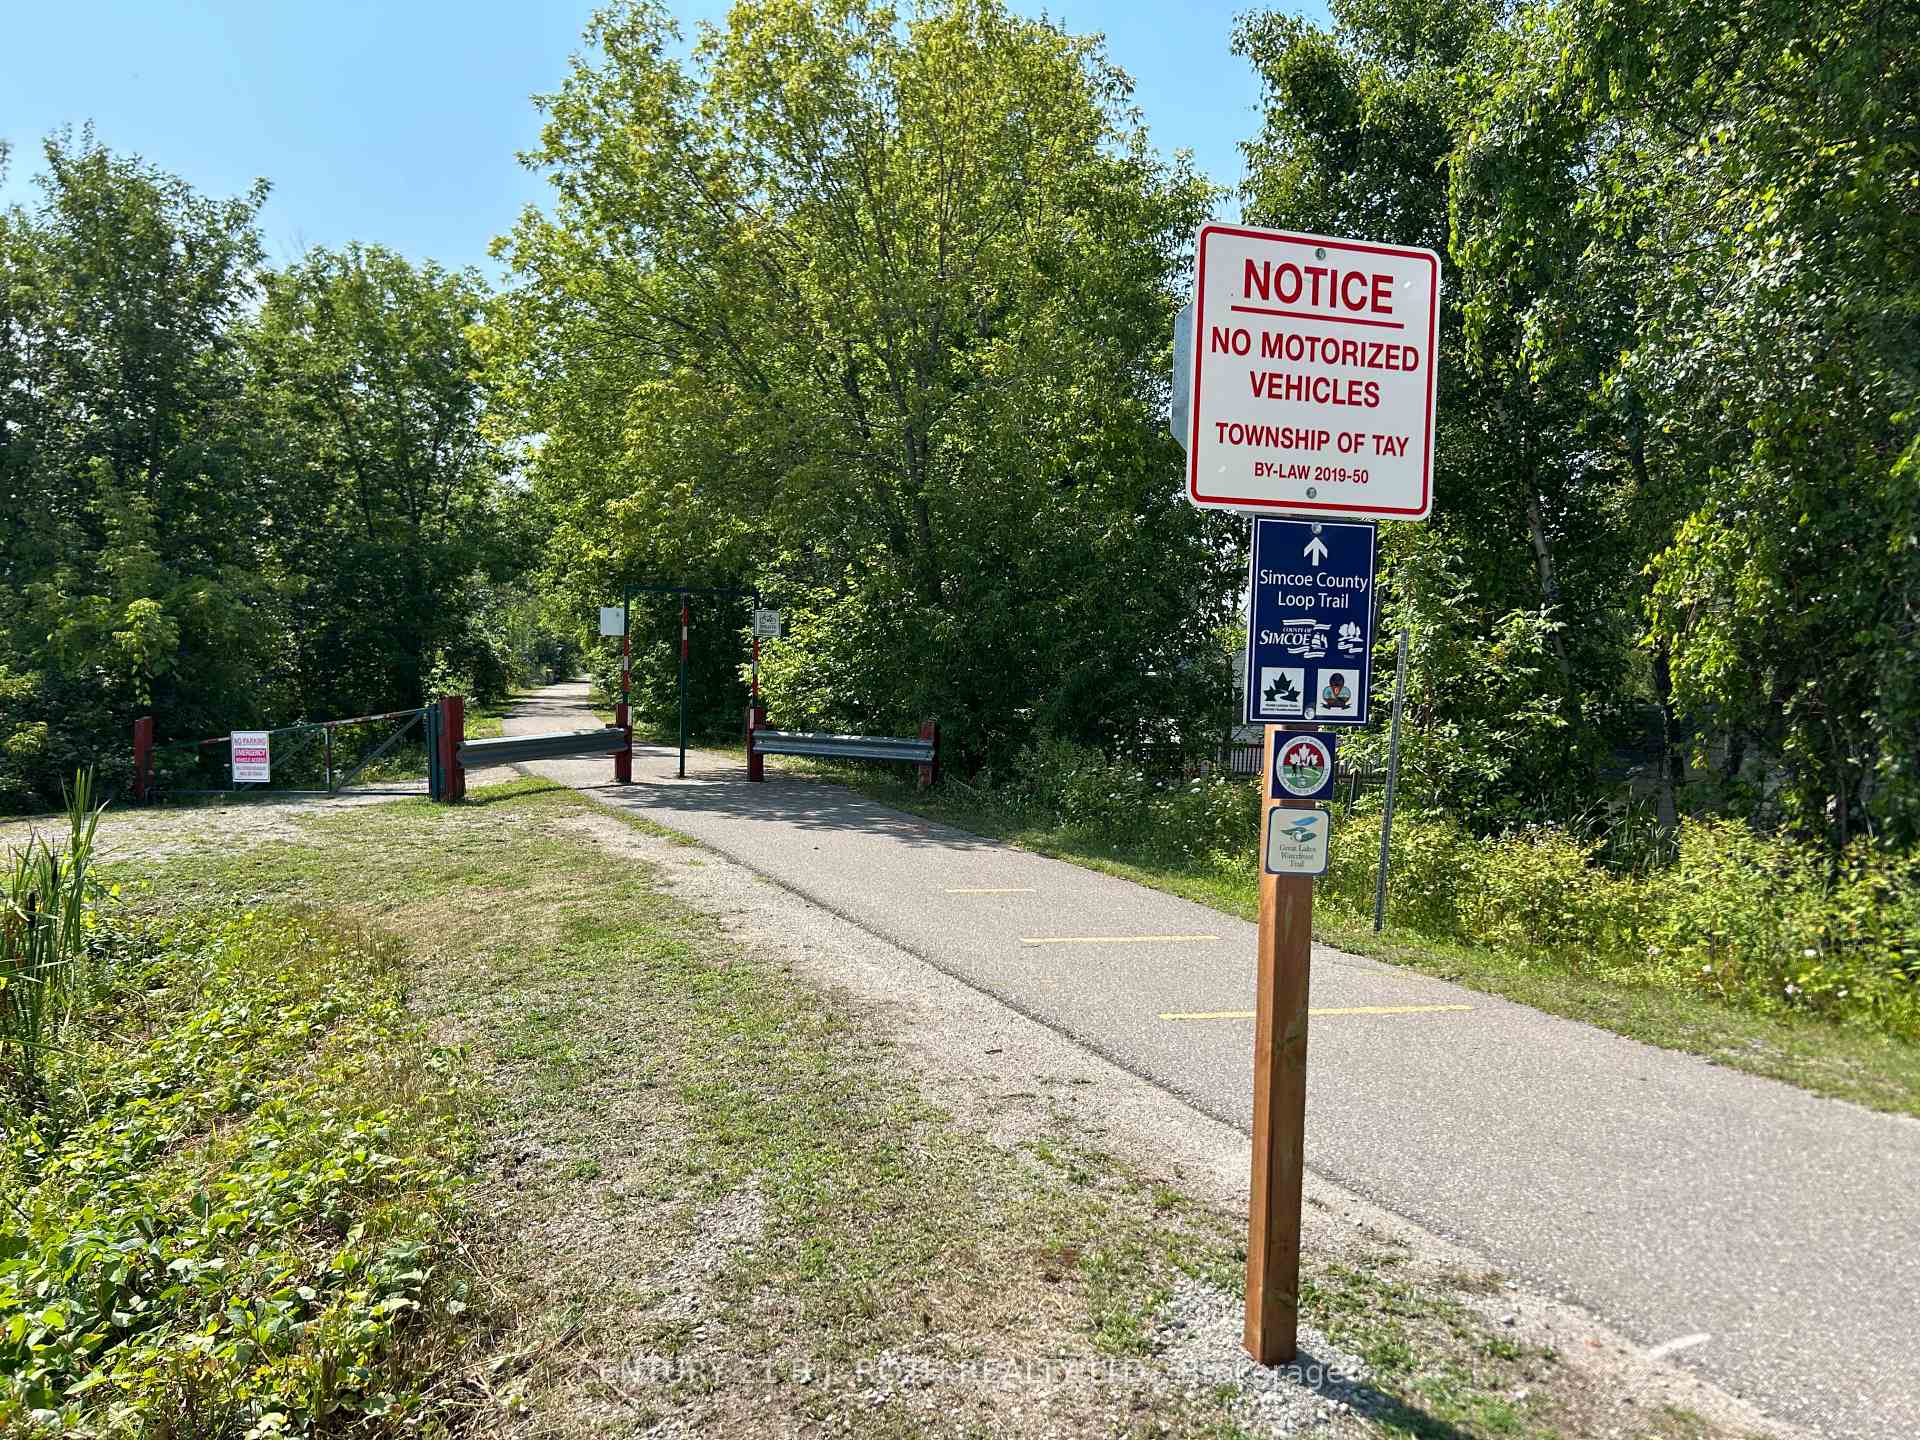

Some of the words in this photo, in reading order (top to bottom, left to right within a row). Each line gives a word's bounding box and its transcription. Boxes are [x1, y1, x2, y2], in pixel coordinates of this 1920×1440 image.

[1243, 259, 1394, 314] NOTICE
[1211, 326, 1251, 356] NO
[1261, 331, 1420, 372] MOTORIZED
[1249, 371, 1380, 408] VEHICLES
[1215, 421, 1330, 451] TOWNSHIP
[1337, 431, 1366, 453] OF
[1372, 434, 1409, 457] TAY
[1254, 462, 1310, 480] BY-LAW
[1314, 467, 1369, 484] 2019-50
[1260, 569, 1313, 586] Simcoe
[1316, 572, 1368, 592] County
[1278, 591, 1315, 611] Loop
[1318, 593, 1349, 608] Trail
[1259, 629, 1312, 646] SIMCOE
